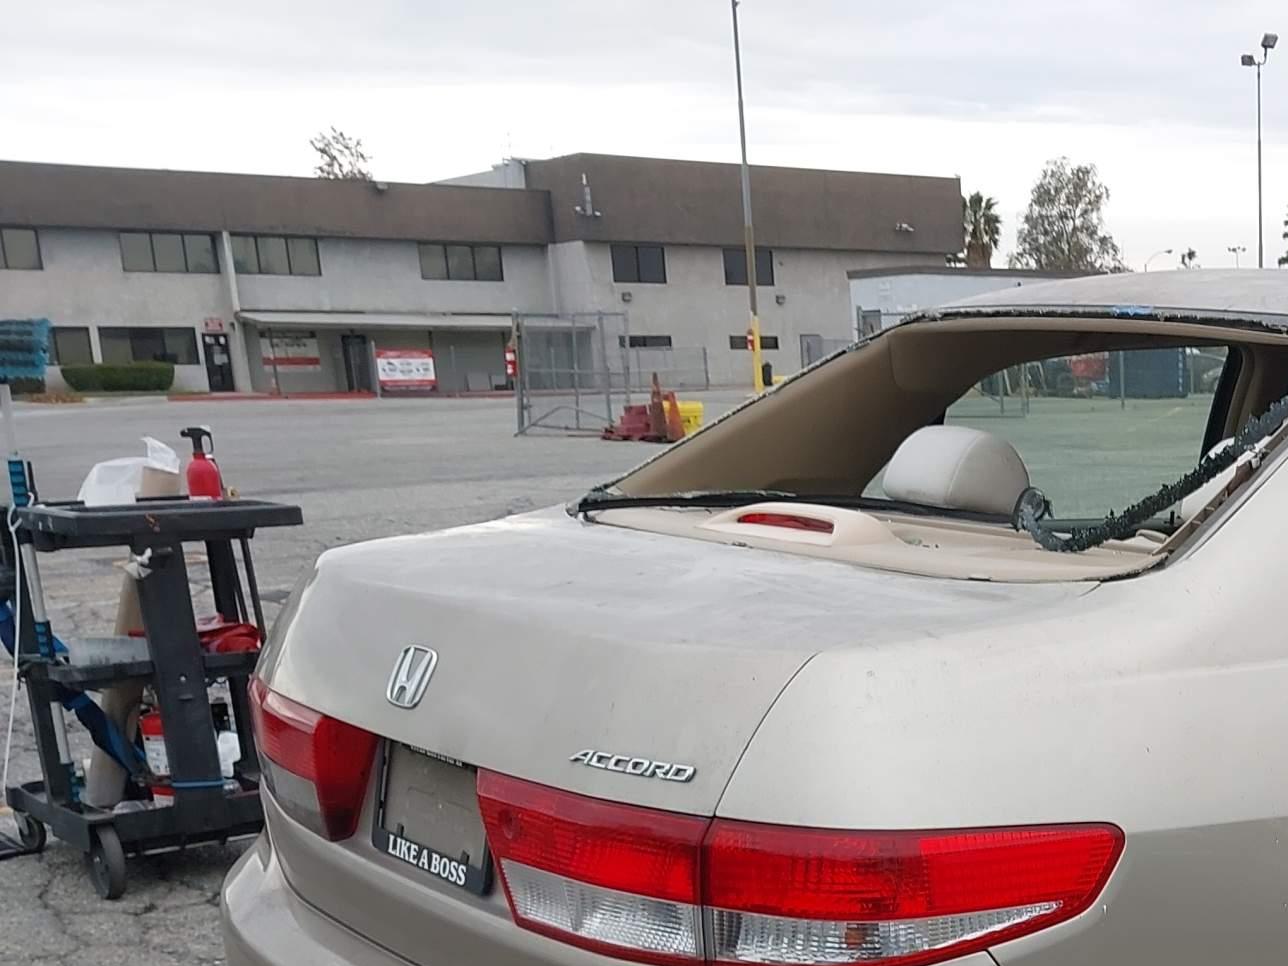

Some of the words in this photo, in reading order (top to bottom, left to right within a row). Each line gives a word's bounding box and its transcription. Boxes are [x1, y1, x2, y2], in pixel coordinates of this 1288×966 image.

[568, 749, 696, 783] ACCORD
[387, 833, 419, 865] LIKE
[418, 848, 430, 870] A
[430, 852, 467, 886] BOSS
